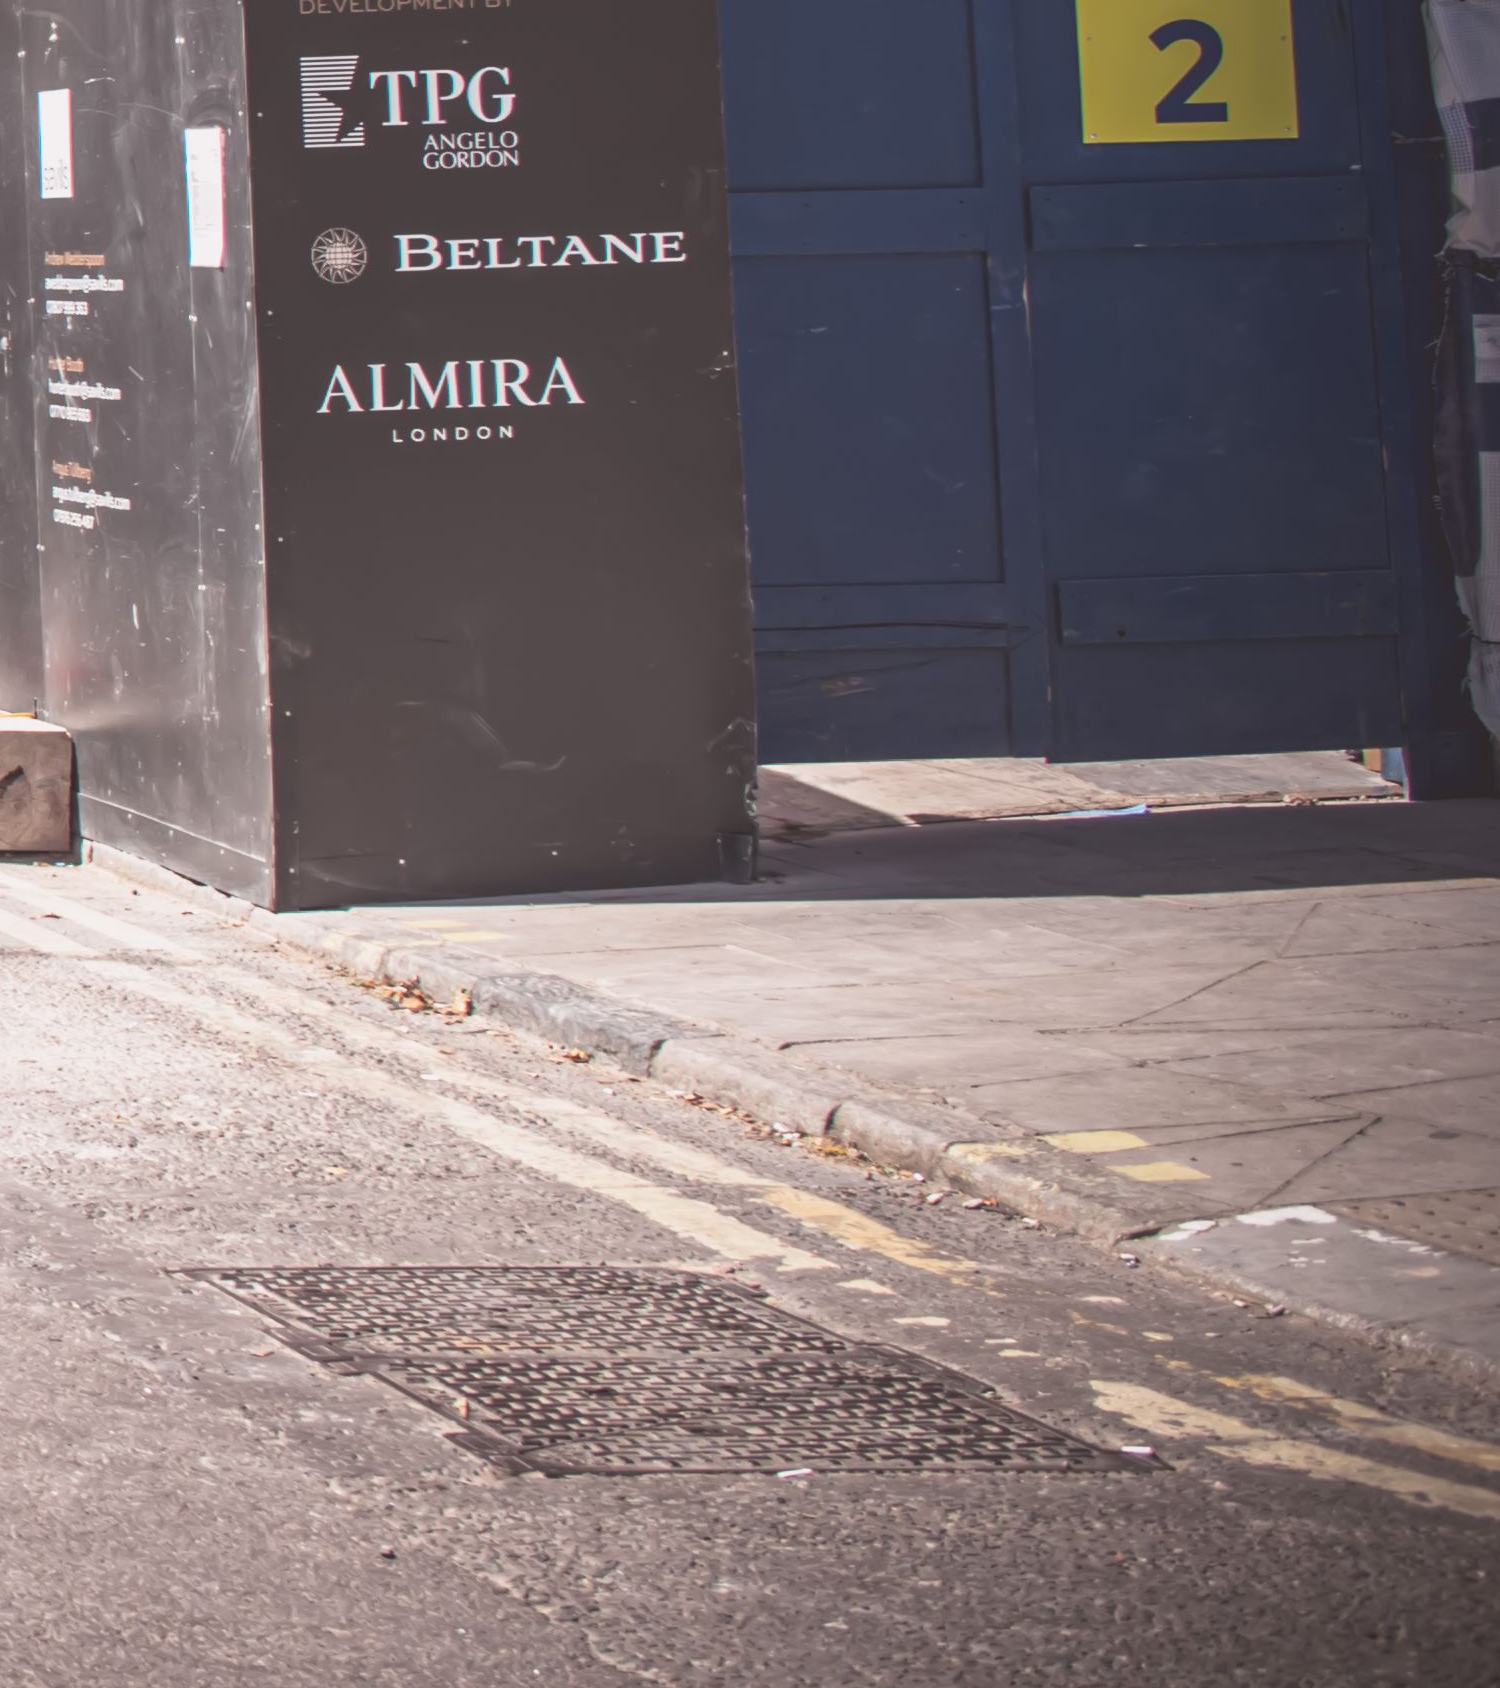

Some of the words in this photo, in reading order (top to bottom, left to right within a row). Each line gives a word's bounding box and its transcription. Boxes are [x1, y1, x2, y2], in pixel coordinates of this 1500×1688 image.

[1148, 19, 1228, 124] 2
[369, 66, 517, 127] TPG
[422, 148, 520, 169] GORDON
[424, 130, 519, 151] ANGELO
[393, 230, 687, 272] BELTANE
[316, 356, 585, 413] ALMIRA
[392, 425, 514, 443] LONDON
